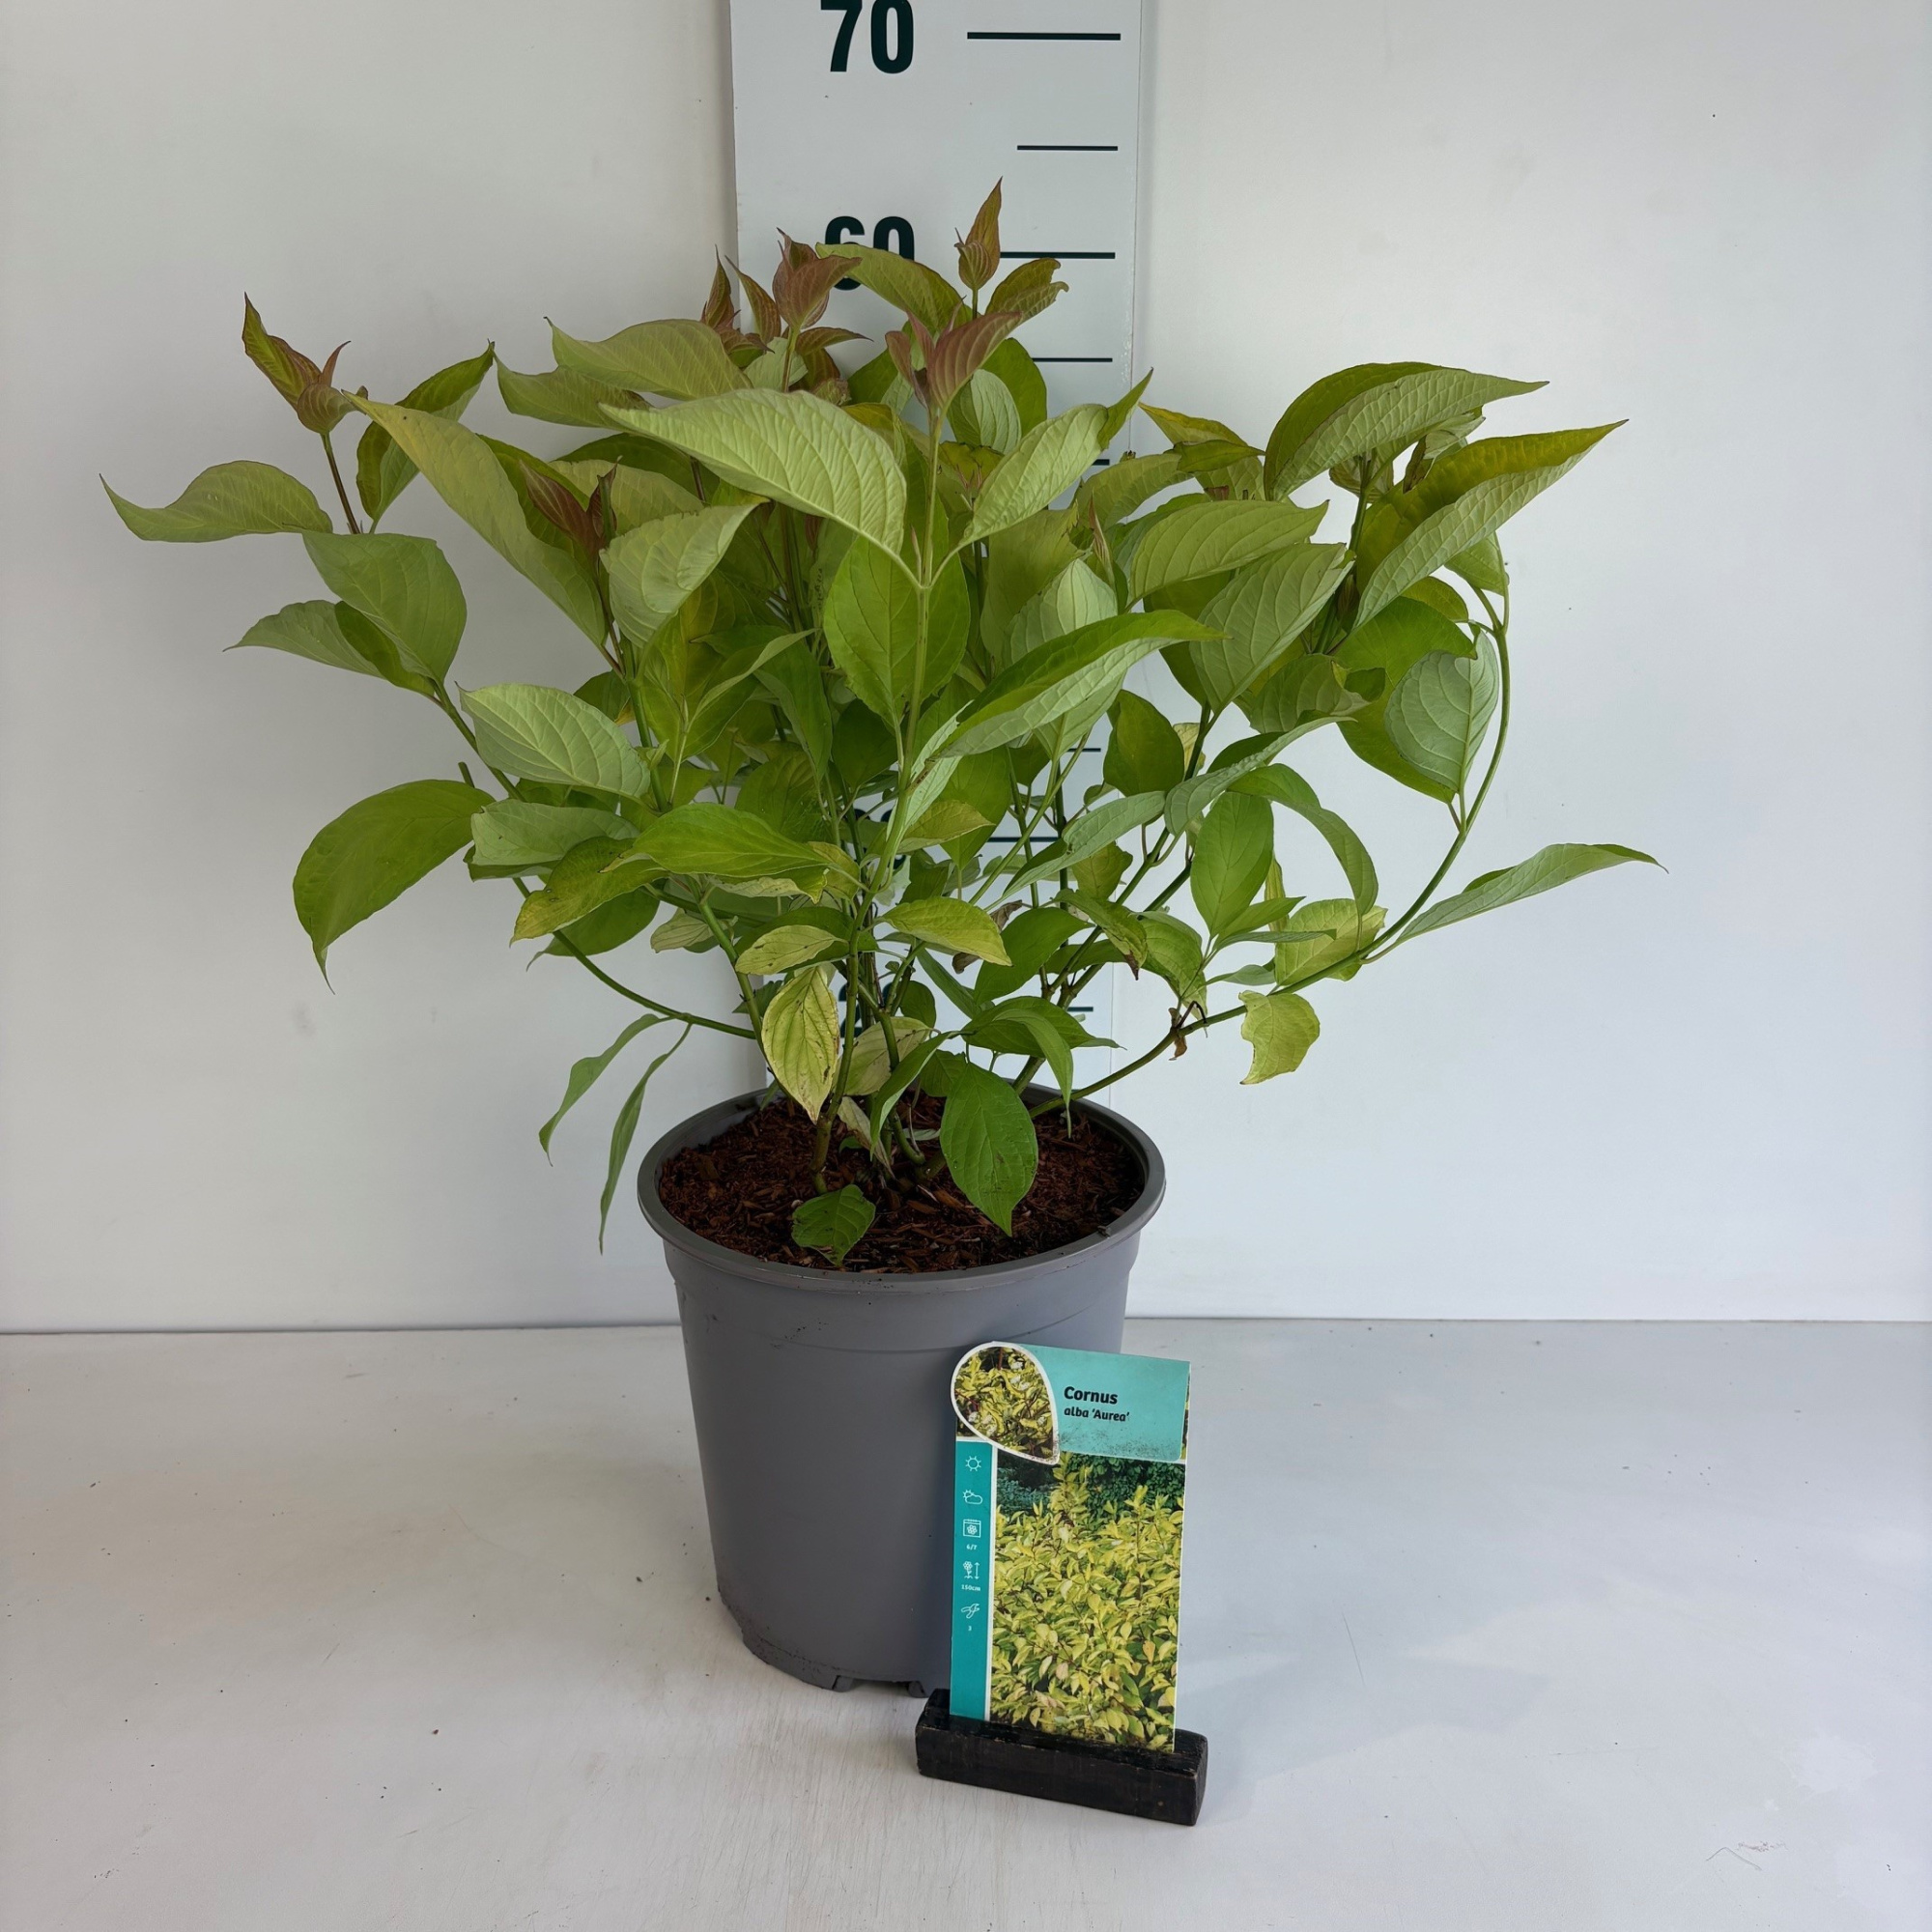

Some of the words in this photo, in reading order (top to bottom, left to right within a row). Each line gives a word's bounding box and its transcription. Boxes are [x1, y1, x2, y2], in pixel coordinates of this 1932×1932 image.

[820, 0, 915, 73] 70
[1064, 1386, 1119, 1405] Cornus
[1064, 1406, 1090, 1418] alba
[961, 1583, 981, 1592] 150cm
